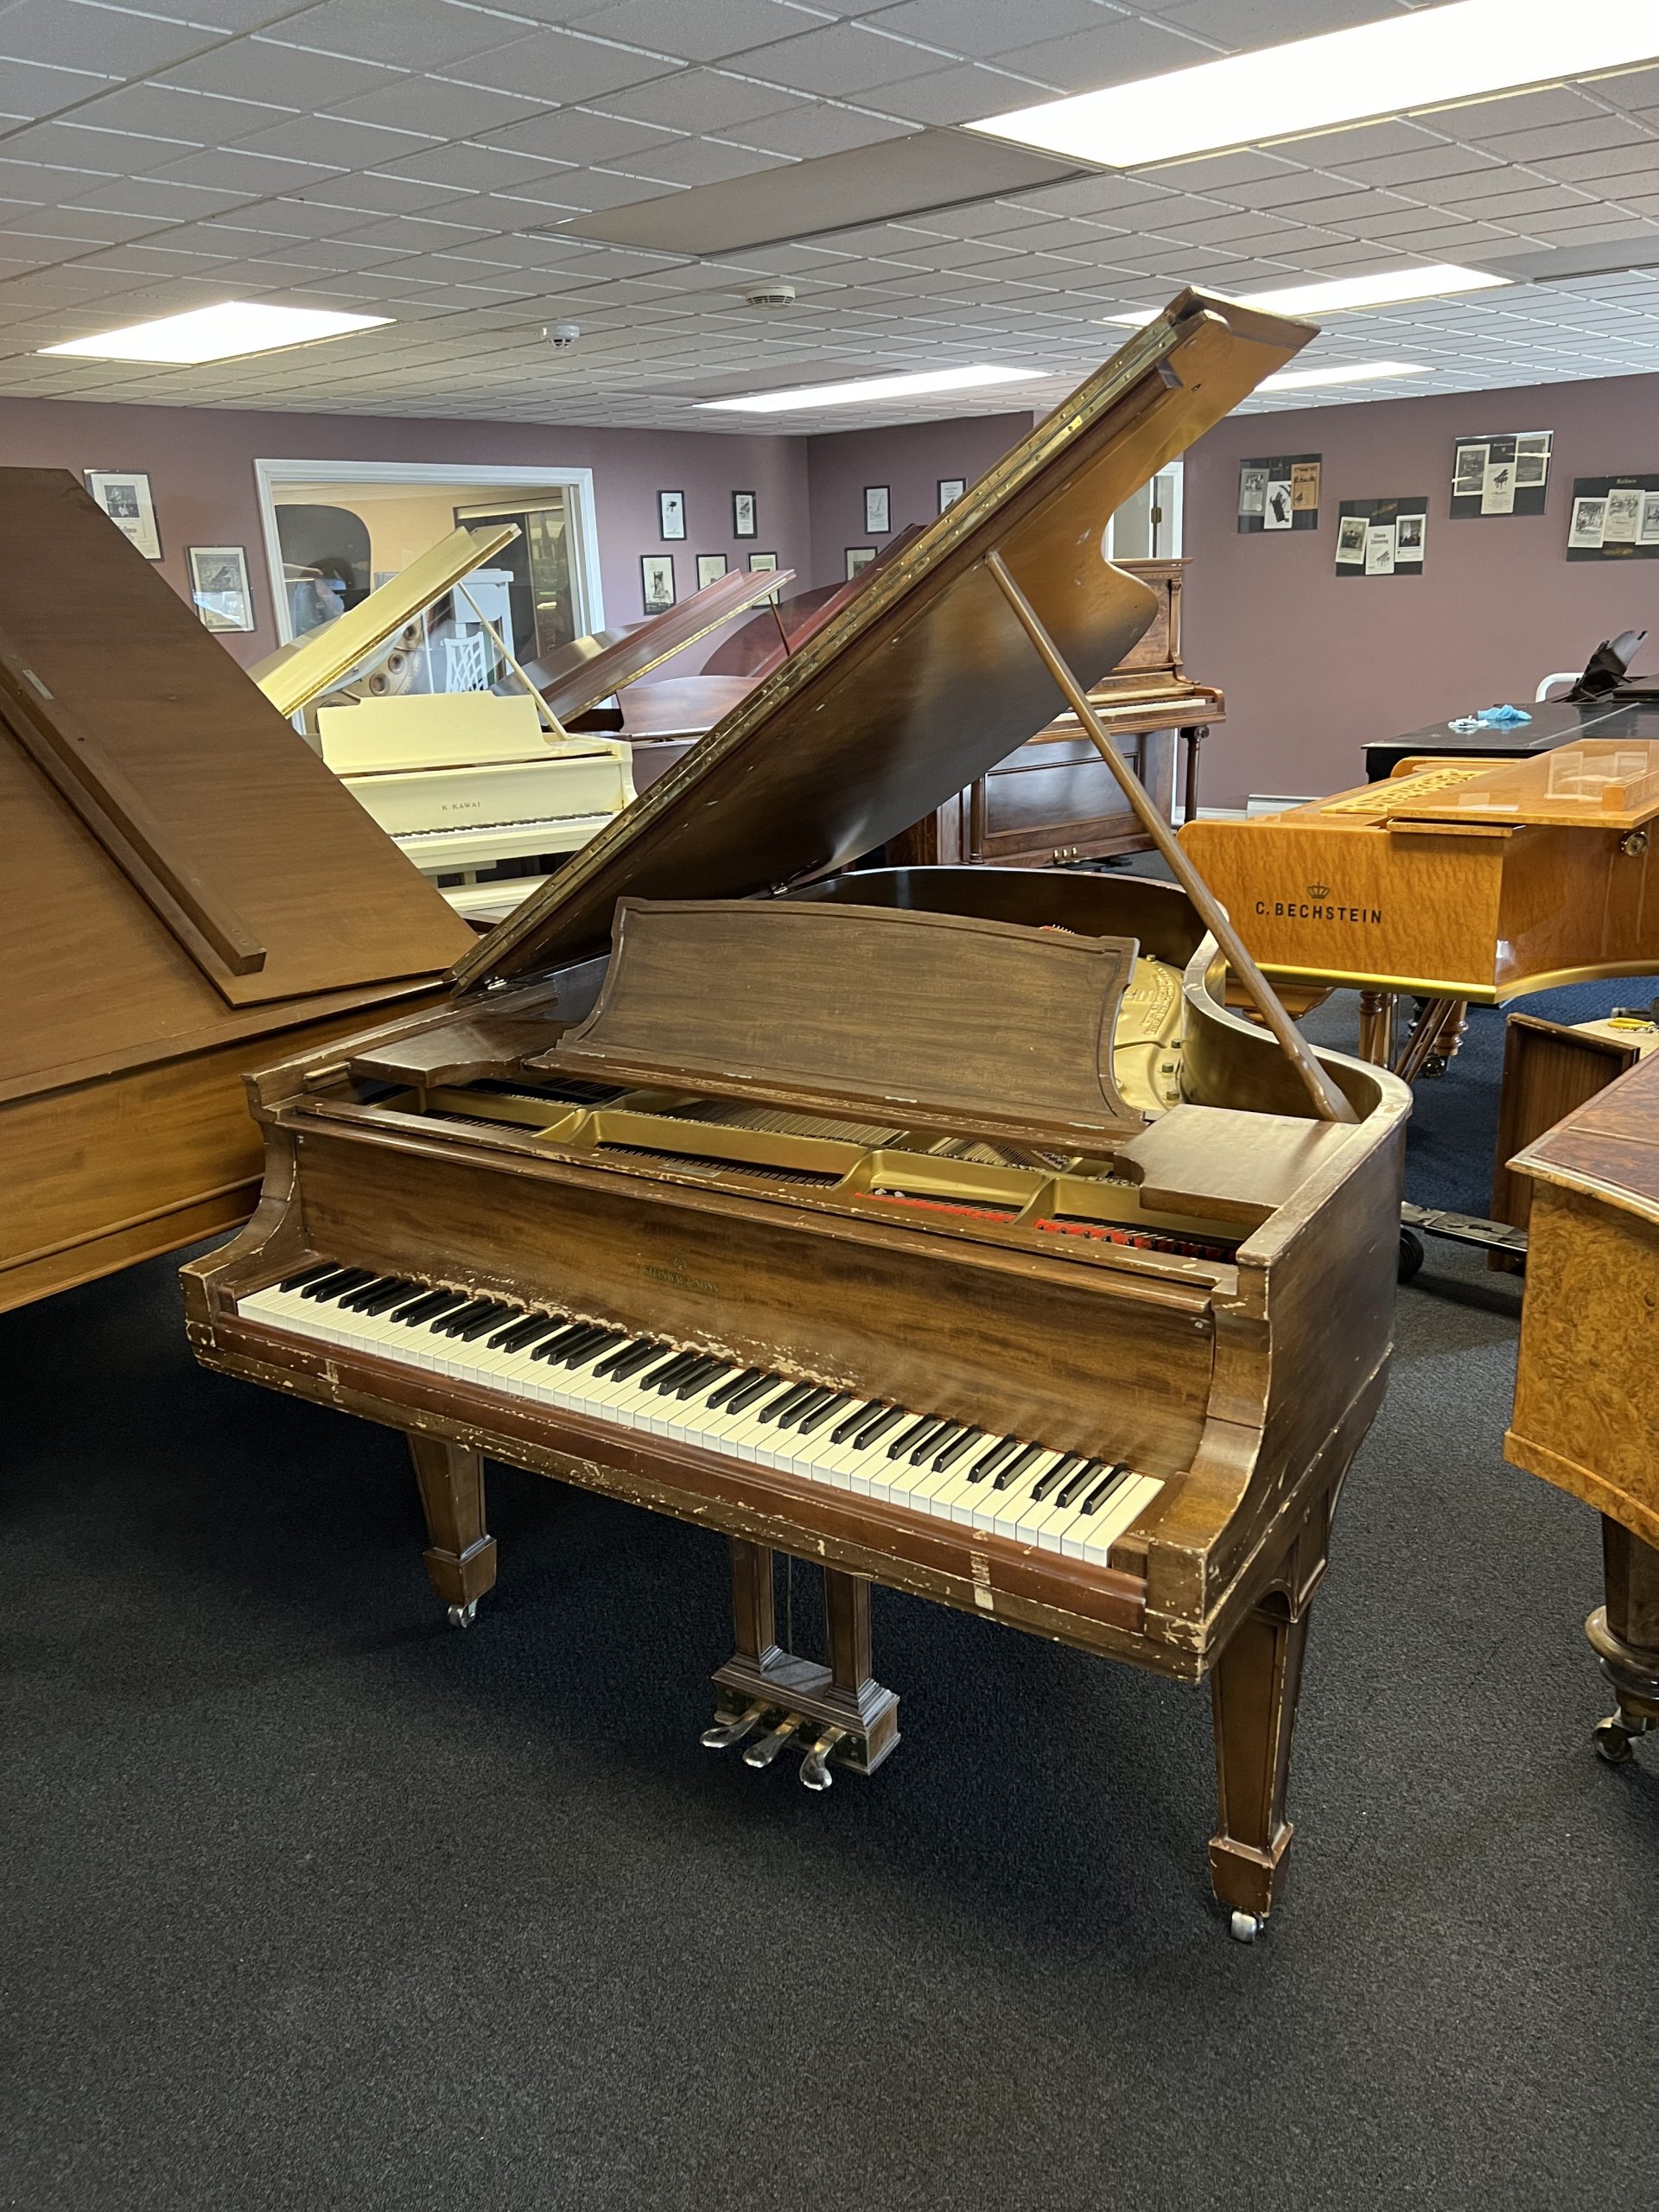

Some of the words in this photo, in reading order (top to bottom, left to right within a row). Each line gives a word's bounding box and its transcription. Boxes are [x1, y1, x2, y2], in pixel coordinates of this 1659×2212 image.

[452, 801, 480, 810] KAWAI
[1255, 901, 1270, 915] C.
[1275, 902, 1382, 924] BECHSTEIN
